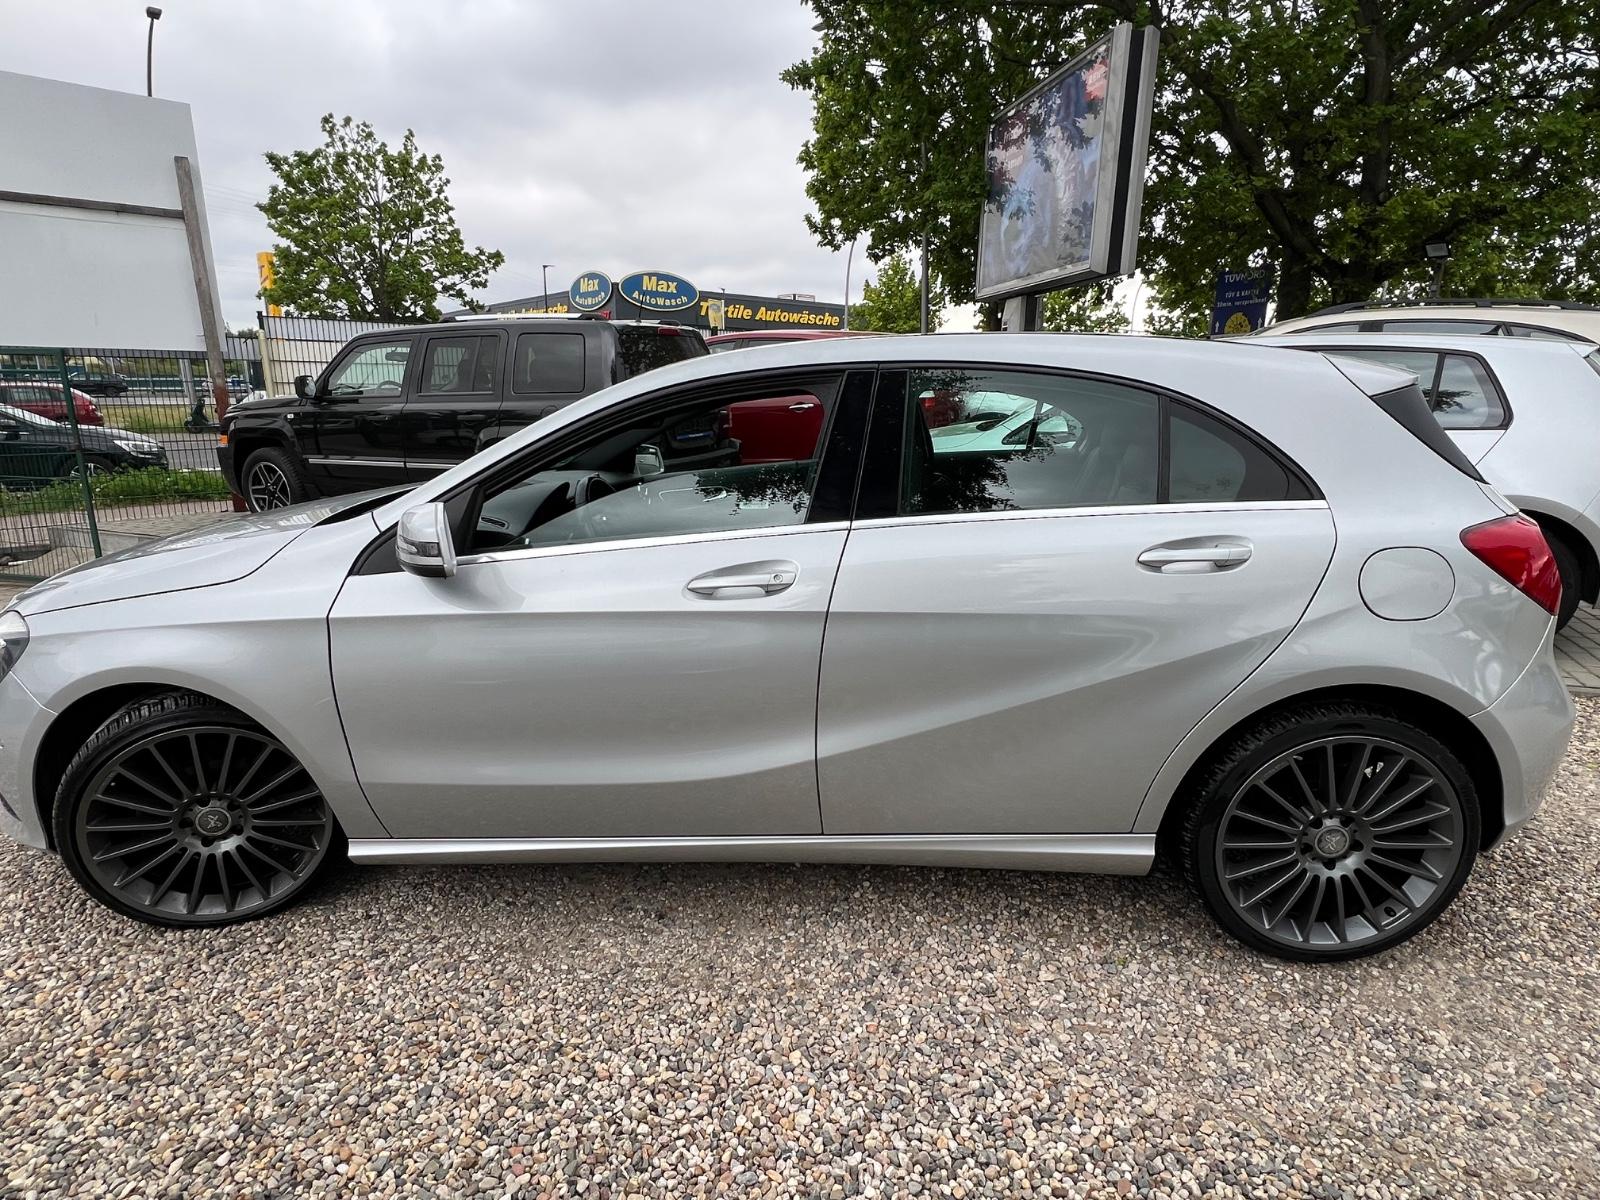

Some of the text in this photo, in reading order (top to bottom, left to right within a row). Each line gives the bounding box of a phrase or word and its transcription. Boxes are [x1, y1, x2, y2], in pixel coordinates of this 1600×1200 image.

[580, 277, 599, 293] Max
[642, 275, 678, 293] Max
[632, 290, 688, 306] AutoWasch
[700, 301, 840, 326] Ttile Autowäsche
